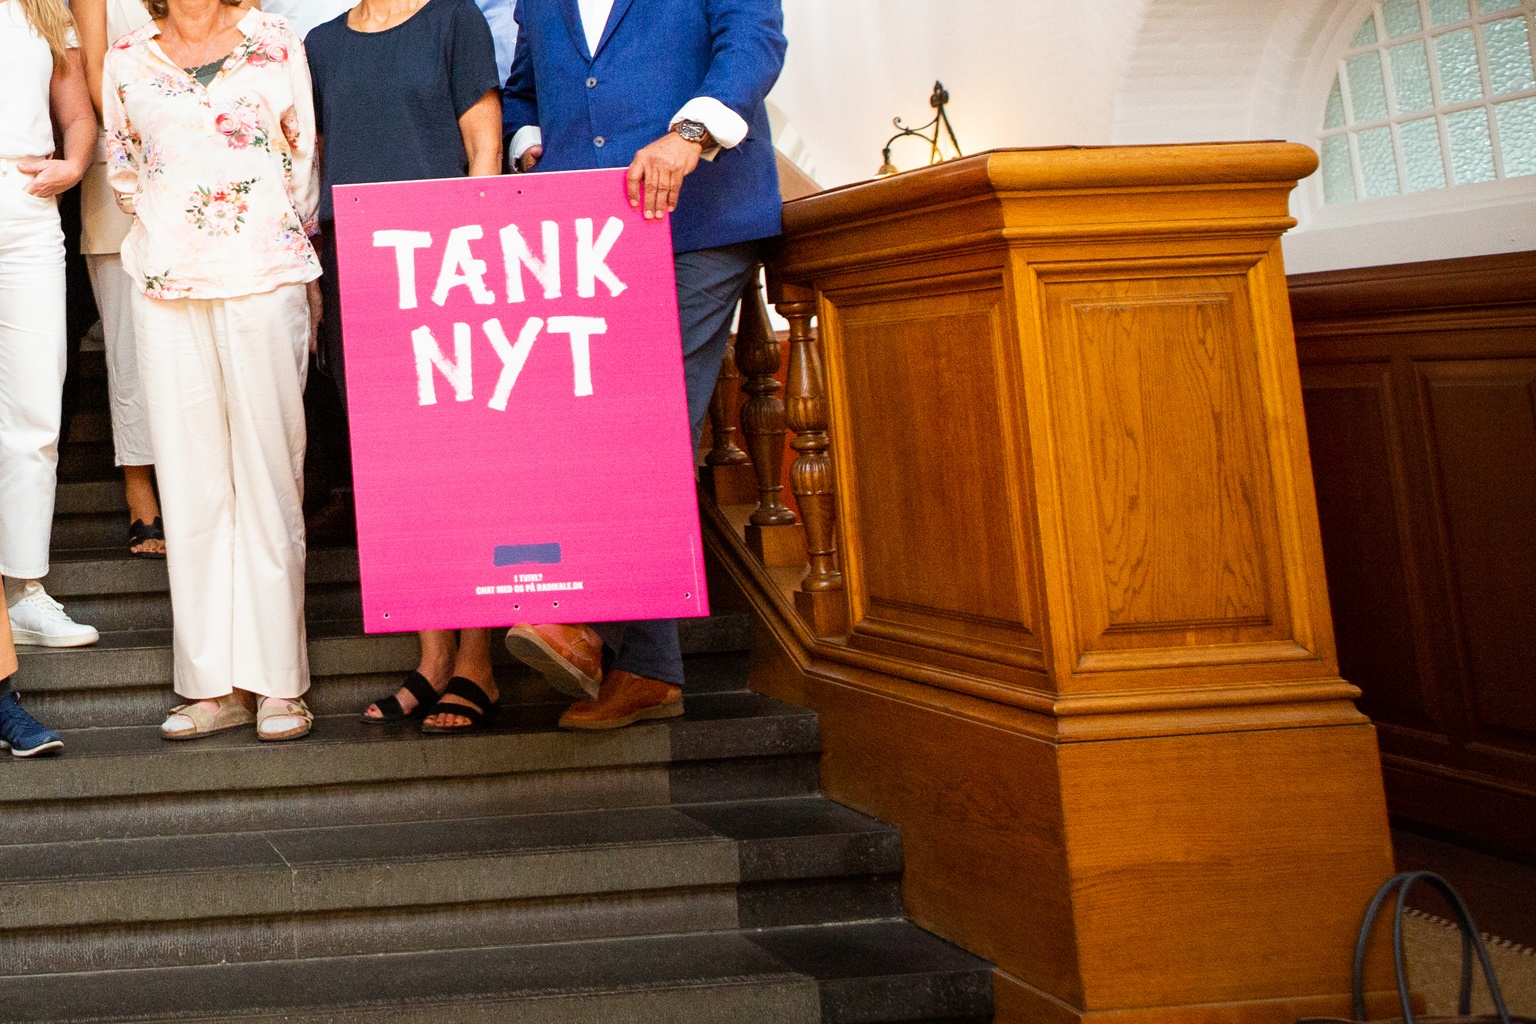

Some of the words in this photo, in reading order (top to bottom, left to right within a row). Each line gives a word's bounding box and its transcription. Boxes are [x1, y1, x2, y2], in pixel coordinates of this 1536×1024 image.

[372, 216, 628, 310] TÆNK
[411, 315, 608, 411] NYT
[476, 585, 495, 594] CHAT
[496, 585, 513, 594] MED
[514, 584, 524, 593] OS
[525, 582, 536, 592] PÅ
[536, 581, 583, 591] RADIKALE.DK
[514, 574, 518, 583] I
[519, 573, 543, 582] TVIVL?
